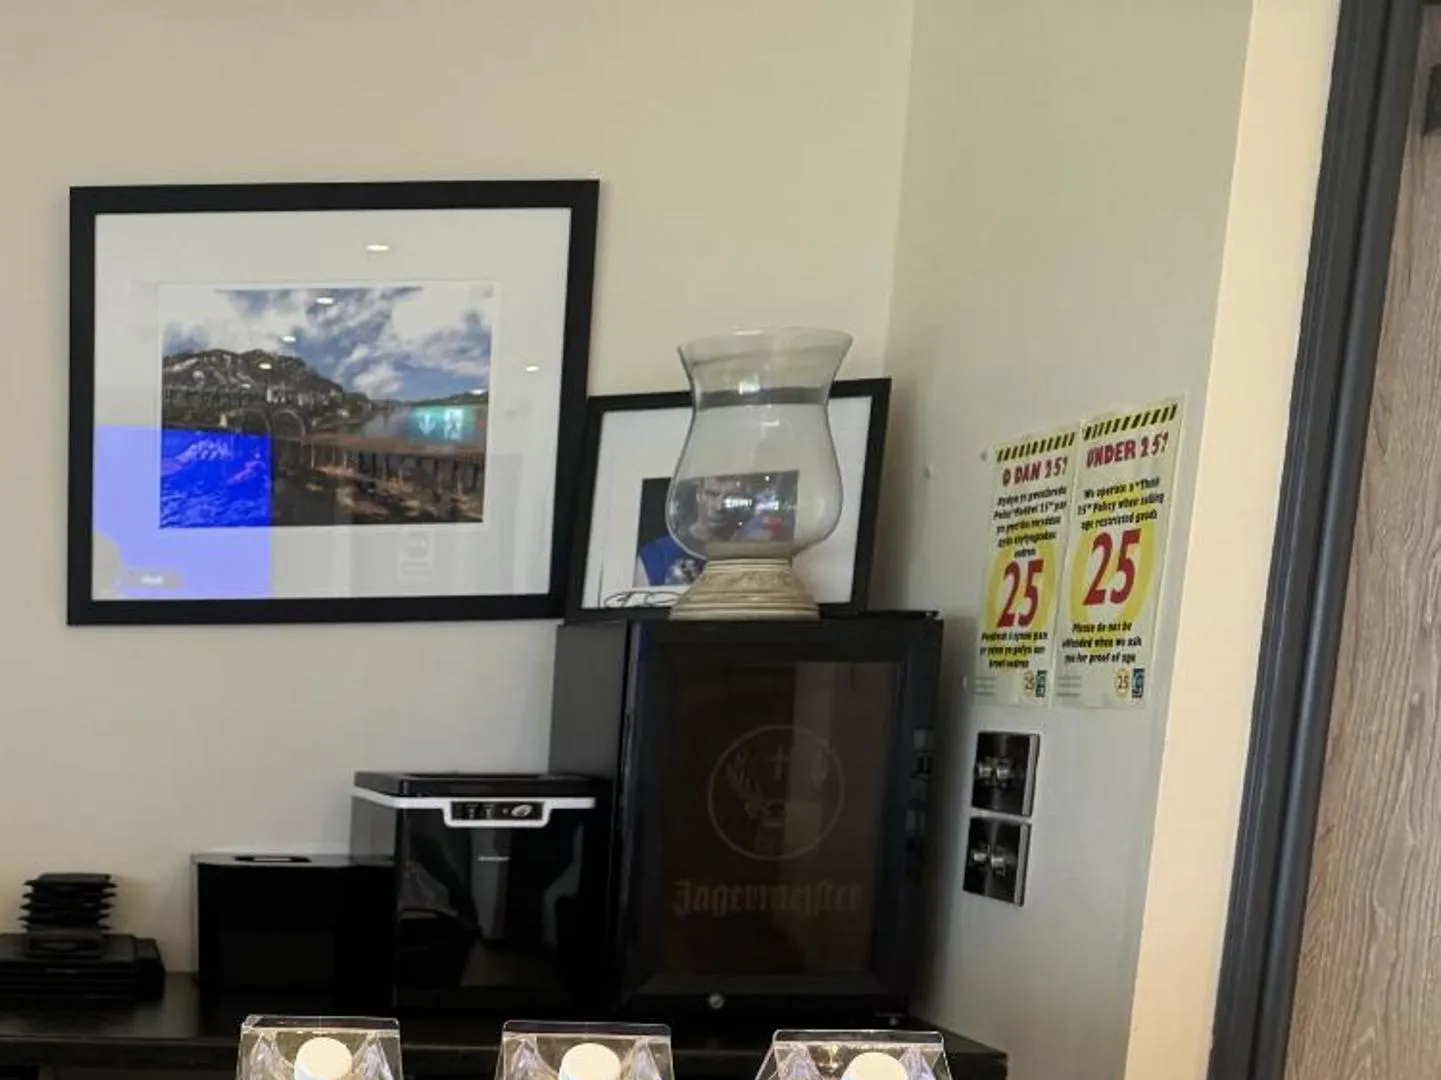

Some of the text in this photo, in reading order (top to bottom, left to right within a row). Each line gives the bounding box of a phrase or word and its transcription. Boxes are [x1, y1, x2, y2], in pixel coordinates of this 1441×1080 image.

[1013, 460, 1041, 485] DAN
[1086, 440, 1136, 468] UNDER
[1082, 528, 1142, 606] 25
[996, 559, 1044, 628] 25
